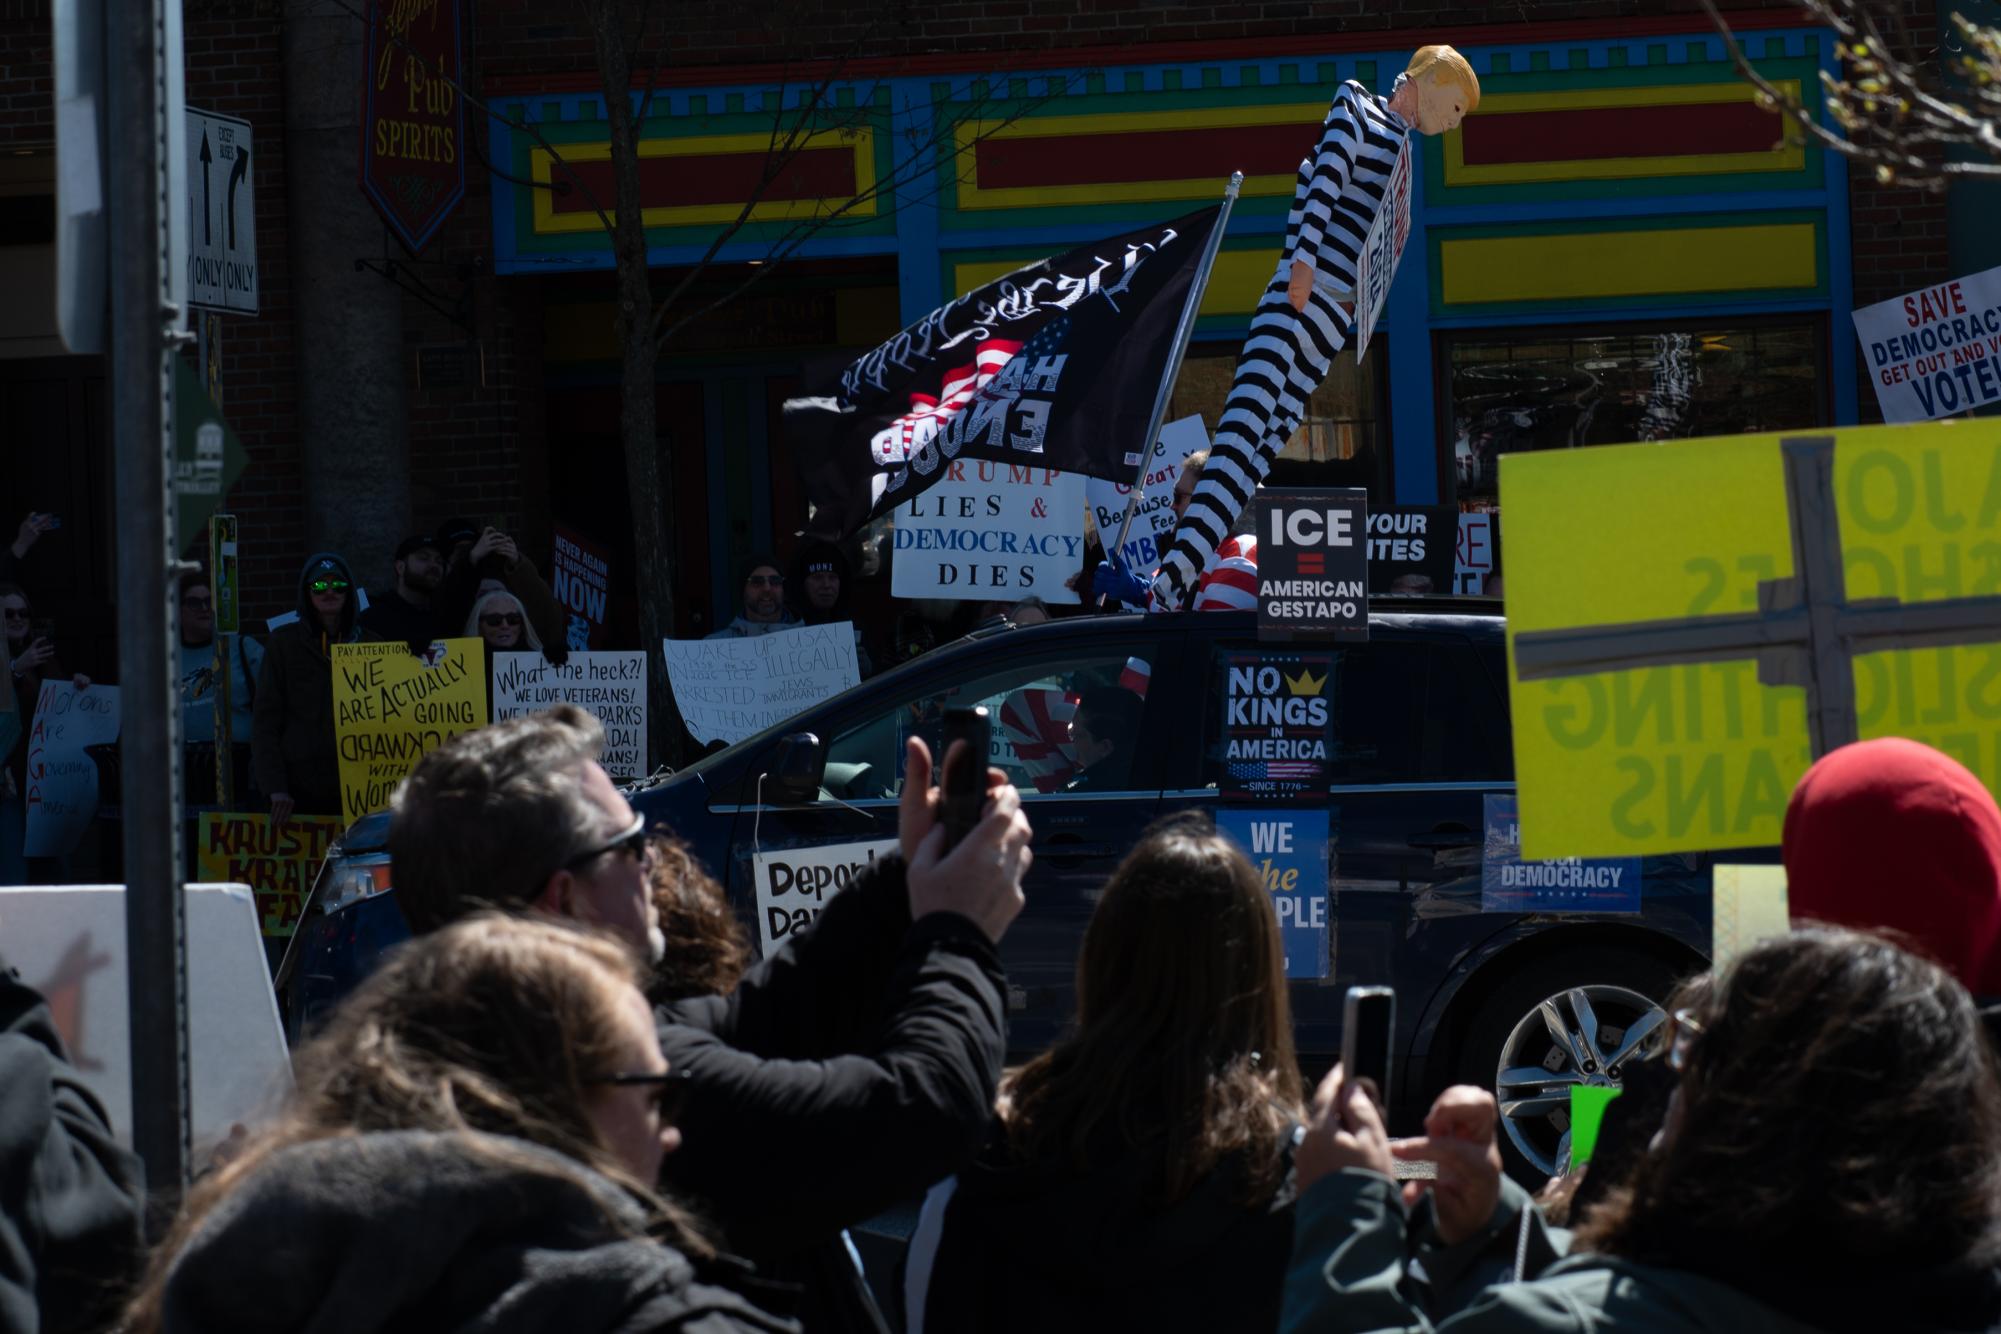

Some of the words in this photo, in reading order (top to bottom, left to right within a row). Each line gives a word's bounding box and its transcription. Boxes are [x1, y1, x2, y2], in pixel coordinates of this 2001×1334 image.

[403, 54, 455, 117] Pub
[376, 117, 455, 164] SPIRITS
[195, 257, 223, 287] ONLY
[226, 262, 254, 292] ONLY
[1904, 282, 1967, 328] SAVE
[1881, 363, 1910, 386] GET
[1916, 352, 1948, 376] OUT
[1953, 341, 1985, 366] AND
[1988, 333, 2001, 354] V
[947, 460, 1060, 486] RUMP
[909, 495, 1001, 517] LIES
[1031, 497, 1048, 518] &
[1271, 508, 1353, 547] ICE
[1366, 513, 1428, 534] YOUR
[555, 535, 581, 560] NEVER
[582, 551, 608, 577] AGAIN
[895, 528, 1082, 557] DEMOCRACY
[555, 551, 564, 566] IS
[938, 563, 1034, 587] DIES
[1259, 580, 1364, 598] AMERICAN
[553, 565, 608, 625] NOW
[1267, 602, 1357, 619] GESTAPO
[336, 646, 354, 657] PAY
[753, 637, 776, 657] UP
[342, 658, 386, 693] WE
[496, 657, 548, 695] What
[588, 658, 643, 681] heck?!
[763, 645, 852, 679] ILLEGALLY
[340, 695, 377, 726] ARE
[380, 653, 467, 723] ACTUALLY
[515, 688, 531, 703] WE
[535, 688, 561, 703] LOVE
[563, 687, 636, 704] VETERANS!
[1228, 666, 1281, 696] NO
[414, 701, 474, 724] GOING
[1227, 697, 1329, 726] KINGS
[1271, 727, 1284, 738] IN
[1226, 739, 1327, 760] AMERICA
[369, 764, 409, 777] WITH
[1250, 822, 1294, 853] WE
[768, 849, 874, 901] Depor
[1501, 865, 1624, 888] DEMOCRACY
